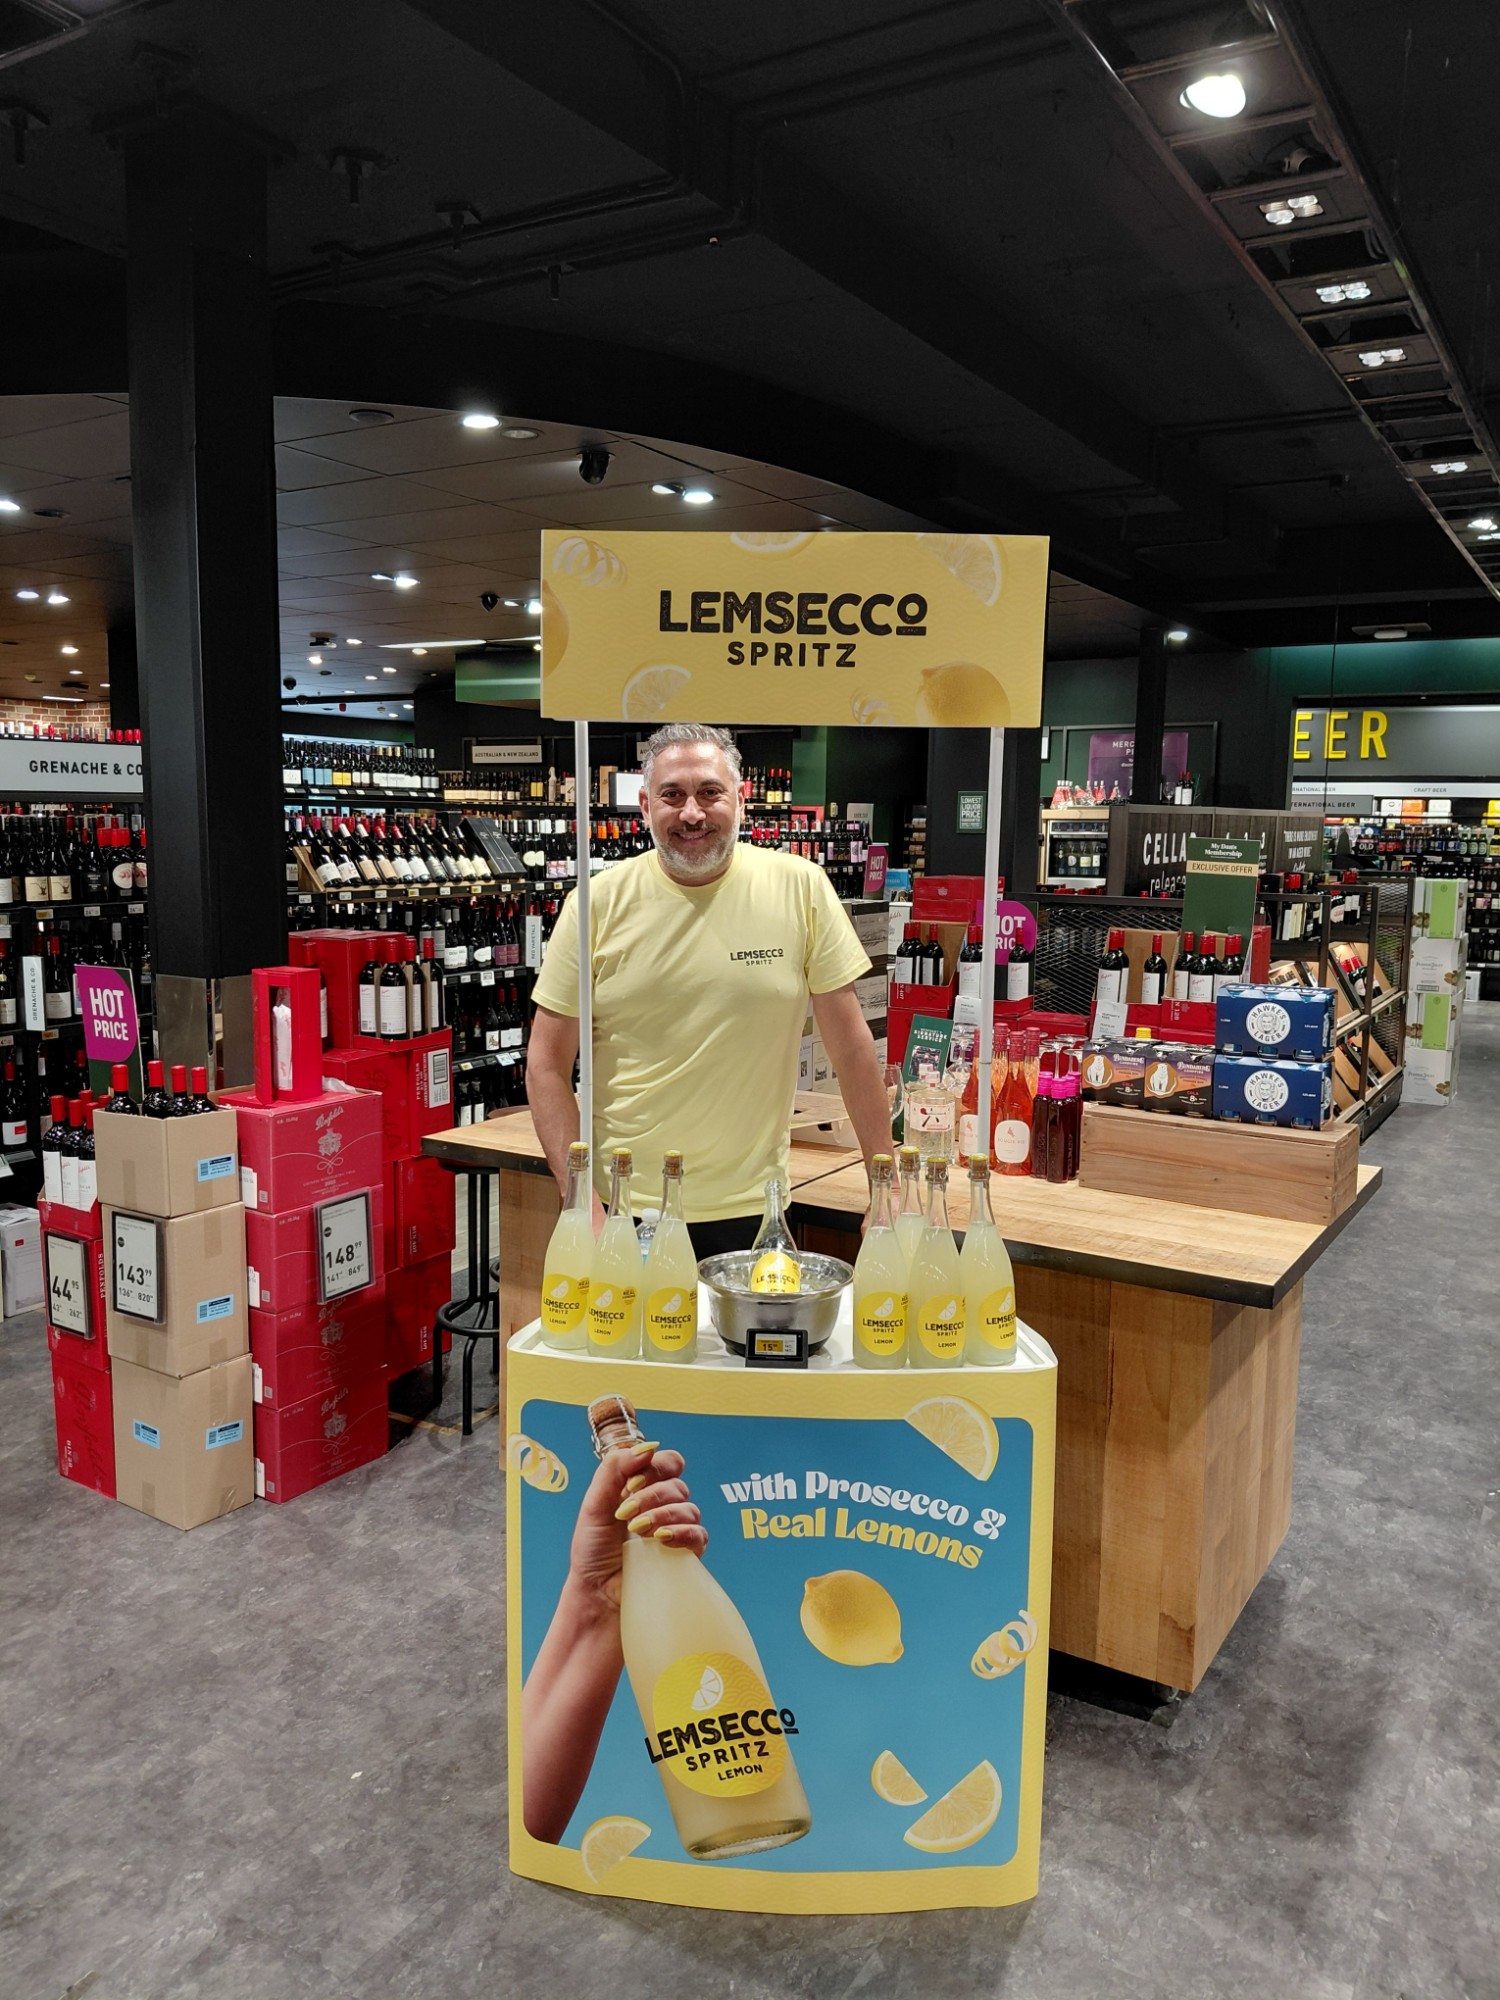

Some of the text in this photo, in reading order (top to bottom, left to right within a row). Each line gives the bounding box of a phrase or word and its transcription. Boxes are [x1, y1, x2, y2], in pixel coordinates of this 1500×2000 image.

[659, 589, 928, 637] LEMSECCO
[726, 640, 857, 668] SPRITZ
[1292, 710, 1390, 760] EER
[29, 760, 109, 775] GRENACHE
[113, 763, 122, 775] &
[962, 810, 981, 818] PRICE
[1143, 831, 1197, 866] CELLA
[1211, 842, 1221, 850] My
[1205, 848, 1243, 859] Membership
[870, 856, 885, 870] HOT
[1192, 863, 1253, 874] EXCLUSIVE OFFER
[869, 870, 883, 881] PRICE
[995, 936, 1016, 950] RIC
[730, 948, 784, 961] LEMSECCO
[31, 984, 39, 1021] GRENACHE
[89, 987, 125, 1019] HOT
[1251, 1004, 1287, 1021] HAWKE'S
[93, 1019, 130, 1041] PRICE
[1253, 1031, 1283, 1042] LAGER
[1177, 1061, 1210, 1072] BUNDABERG
[1249, 1072, 1284, 1088] HAWKE'S
[1251, 1098, 1281, 1110] LAGER
[325, 1244, 356, 1269] 148
[97, 1253, 106, 1299] PENFOLDS
[118, 1263, 145, 1287] 143
[52, 1275, 79, 1301] 44 95
[137, 1292, 151, 1303] 820
[543, 1298, 580, 1310] LEMSECCO
[548, 1307, 569, 1315] SPRITZ
[588, 1307, 625, 1320] LEMSECCO
[593, 1317, 613, 1325] SPRITZ
[650, 1314, 692, 1324] LEMSECCO
[862, 1317, 904, 1328] LEMSECCO
[594, 1328, 612, 1336] LEMON
[762, 1343, 773, 1351] 15
[719, 1471, 1007, 1540] with Prosecco &
[740, 1507, 983, 1569] Real Lemons
[644, 1708, 799, 1764] LEMSECCO
[685, 1740, 770, 1772] SPRITZ
[717, 1764, 763, 1781] LEMON
